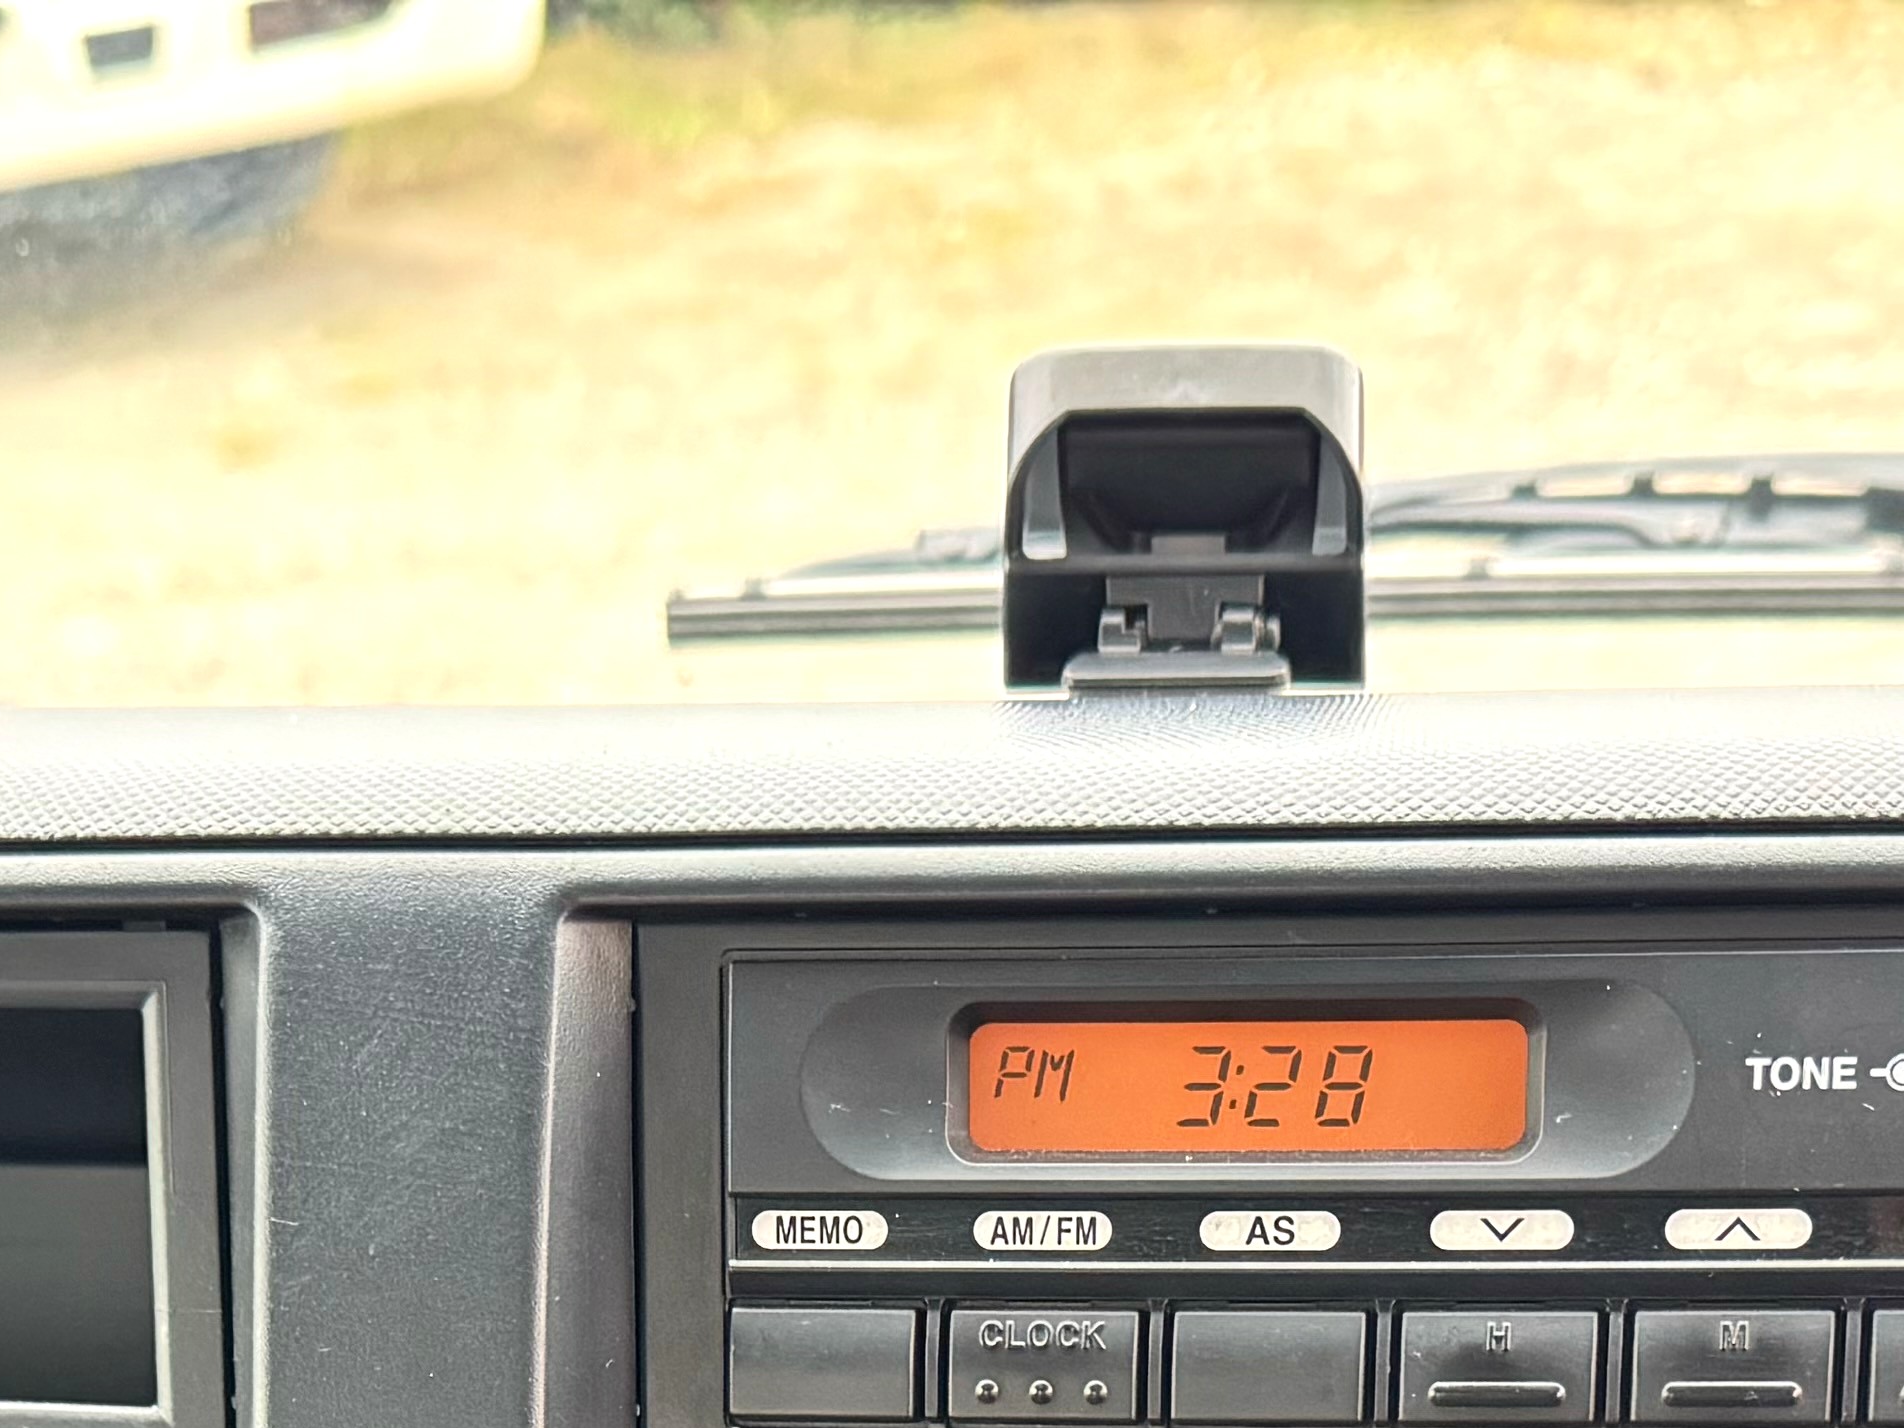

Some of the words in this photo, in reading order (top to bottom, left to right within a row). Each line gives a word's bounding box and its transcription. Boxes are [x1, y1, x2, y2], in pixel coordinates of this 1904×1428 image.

[995, 1045, 1074, 1103] PM
[1176, 1045, 1374, 1129] 3:28
[1746, 1055, 1858, 1091] TONE
[775, 1215, 864, 1245] MEMO
[990, 1215, 1098, 1246] AM/FM
[1245, 1215, 1296, 1246] AS
[978, 1319, 1106, 1350] CLOCK
[1486, 1321, 1511, 1352] H
[1719, 1320, 1749, 1351] M
